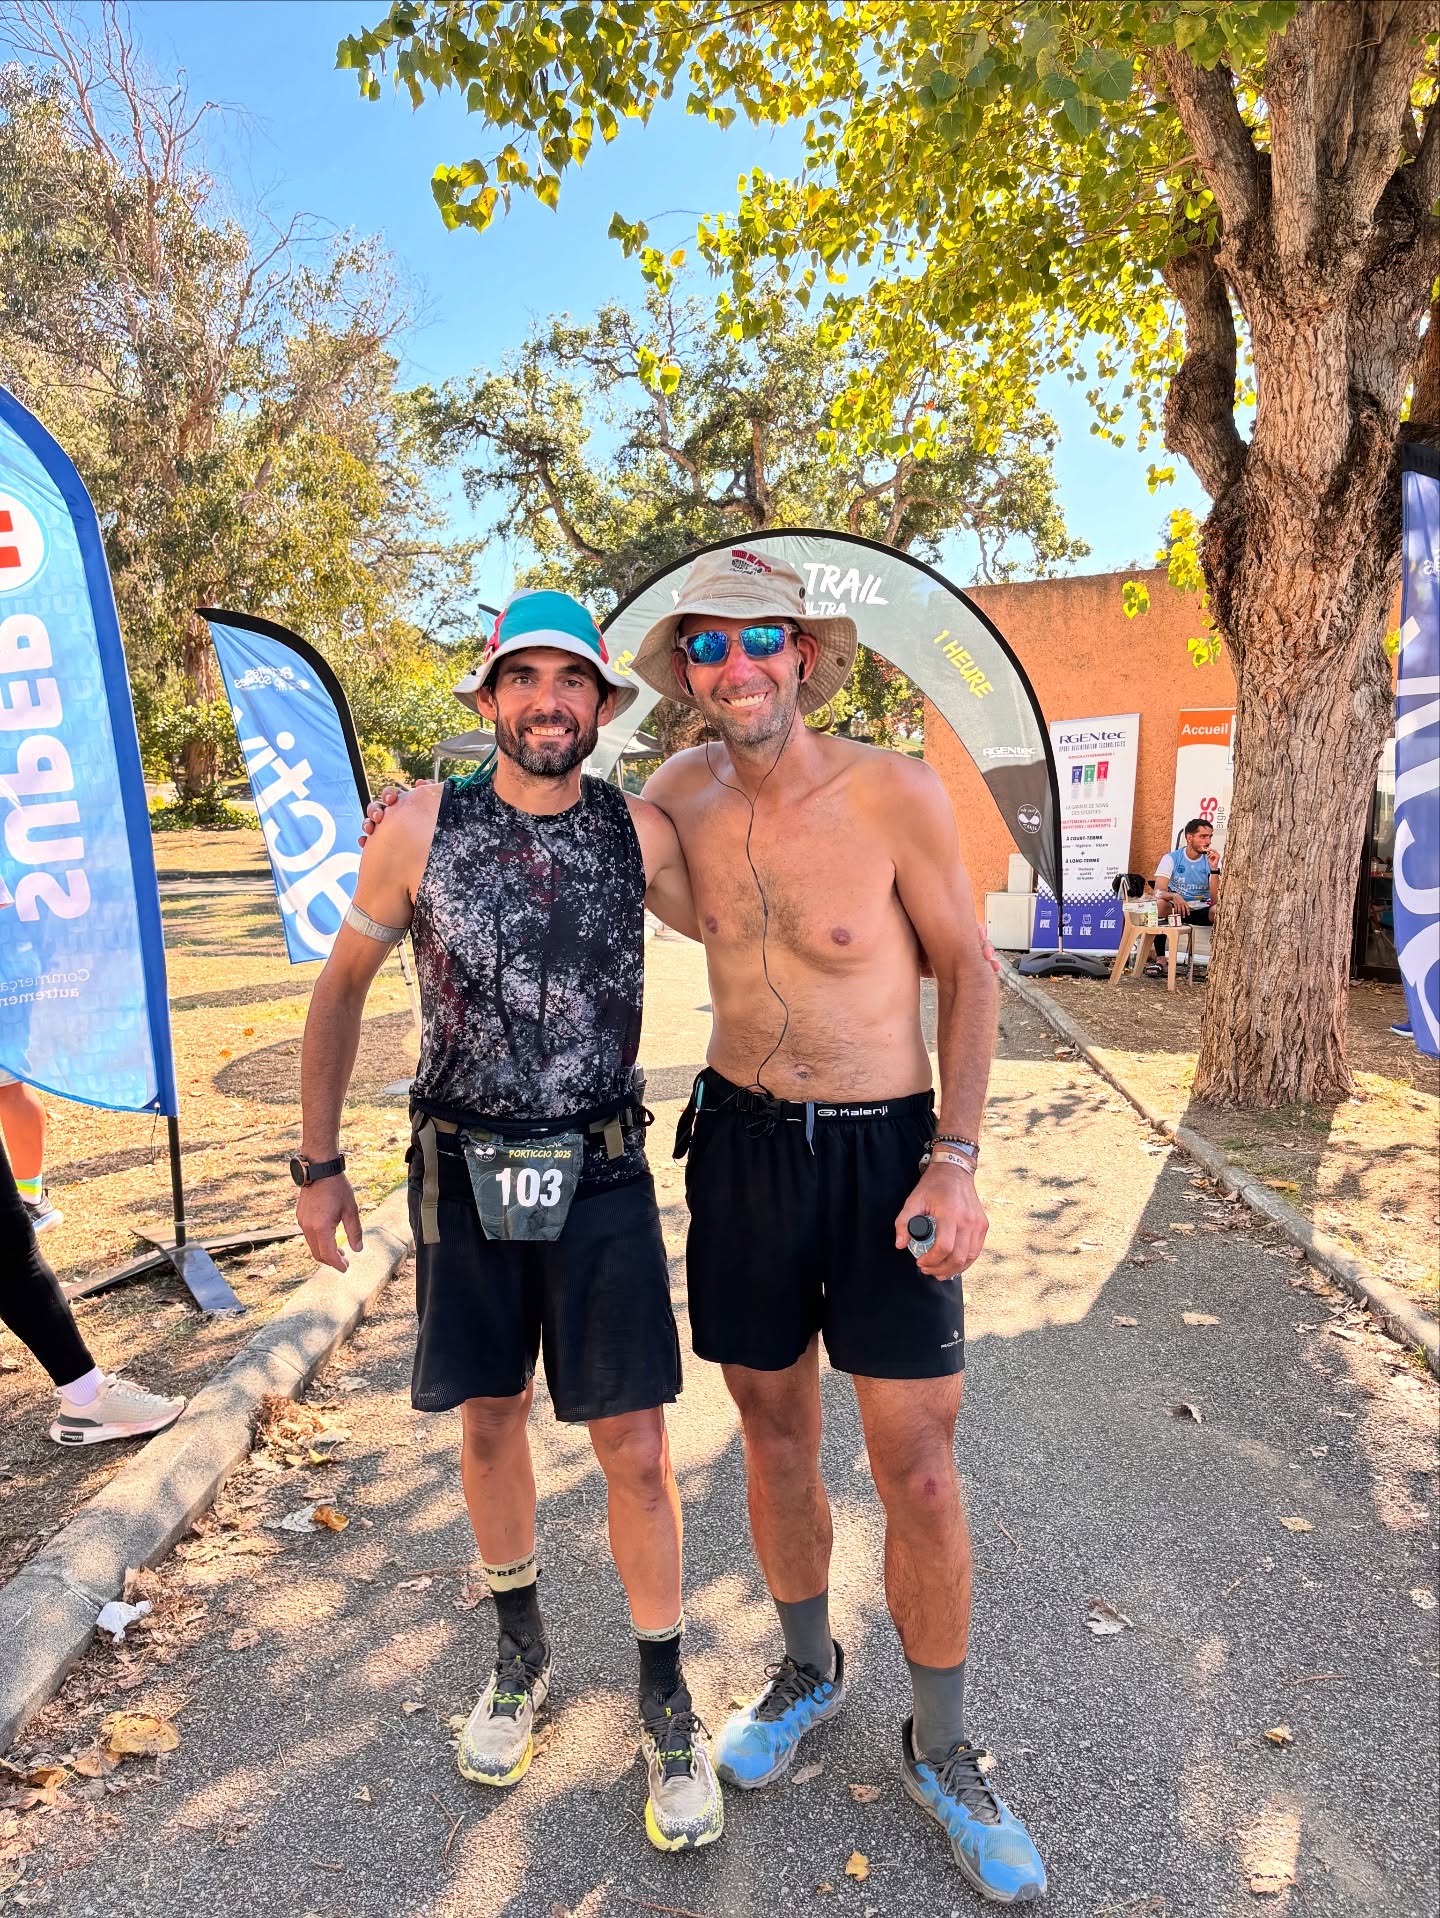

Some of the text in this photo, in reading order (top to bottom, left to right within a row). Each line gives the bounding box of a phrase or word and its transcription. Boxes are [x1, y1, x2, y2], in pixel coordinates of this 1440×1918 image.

[802, 562, 889, 605] TRAIL
[934, 629, 994, 699] 1 HEURE
[1181, 723, 1229, 735] Accueil
[840, 1105, 888, 1117] Kalenji
[508, 1149, 572, 1159] PORTICCIO 2025
[495, 1167, 563, 1207] 103
